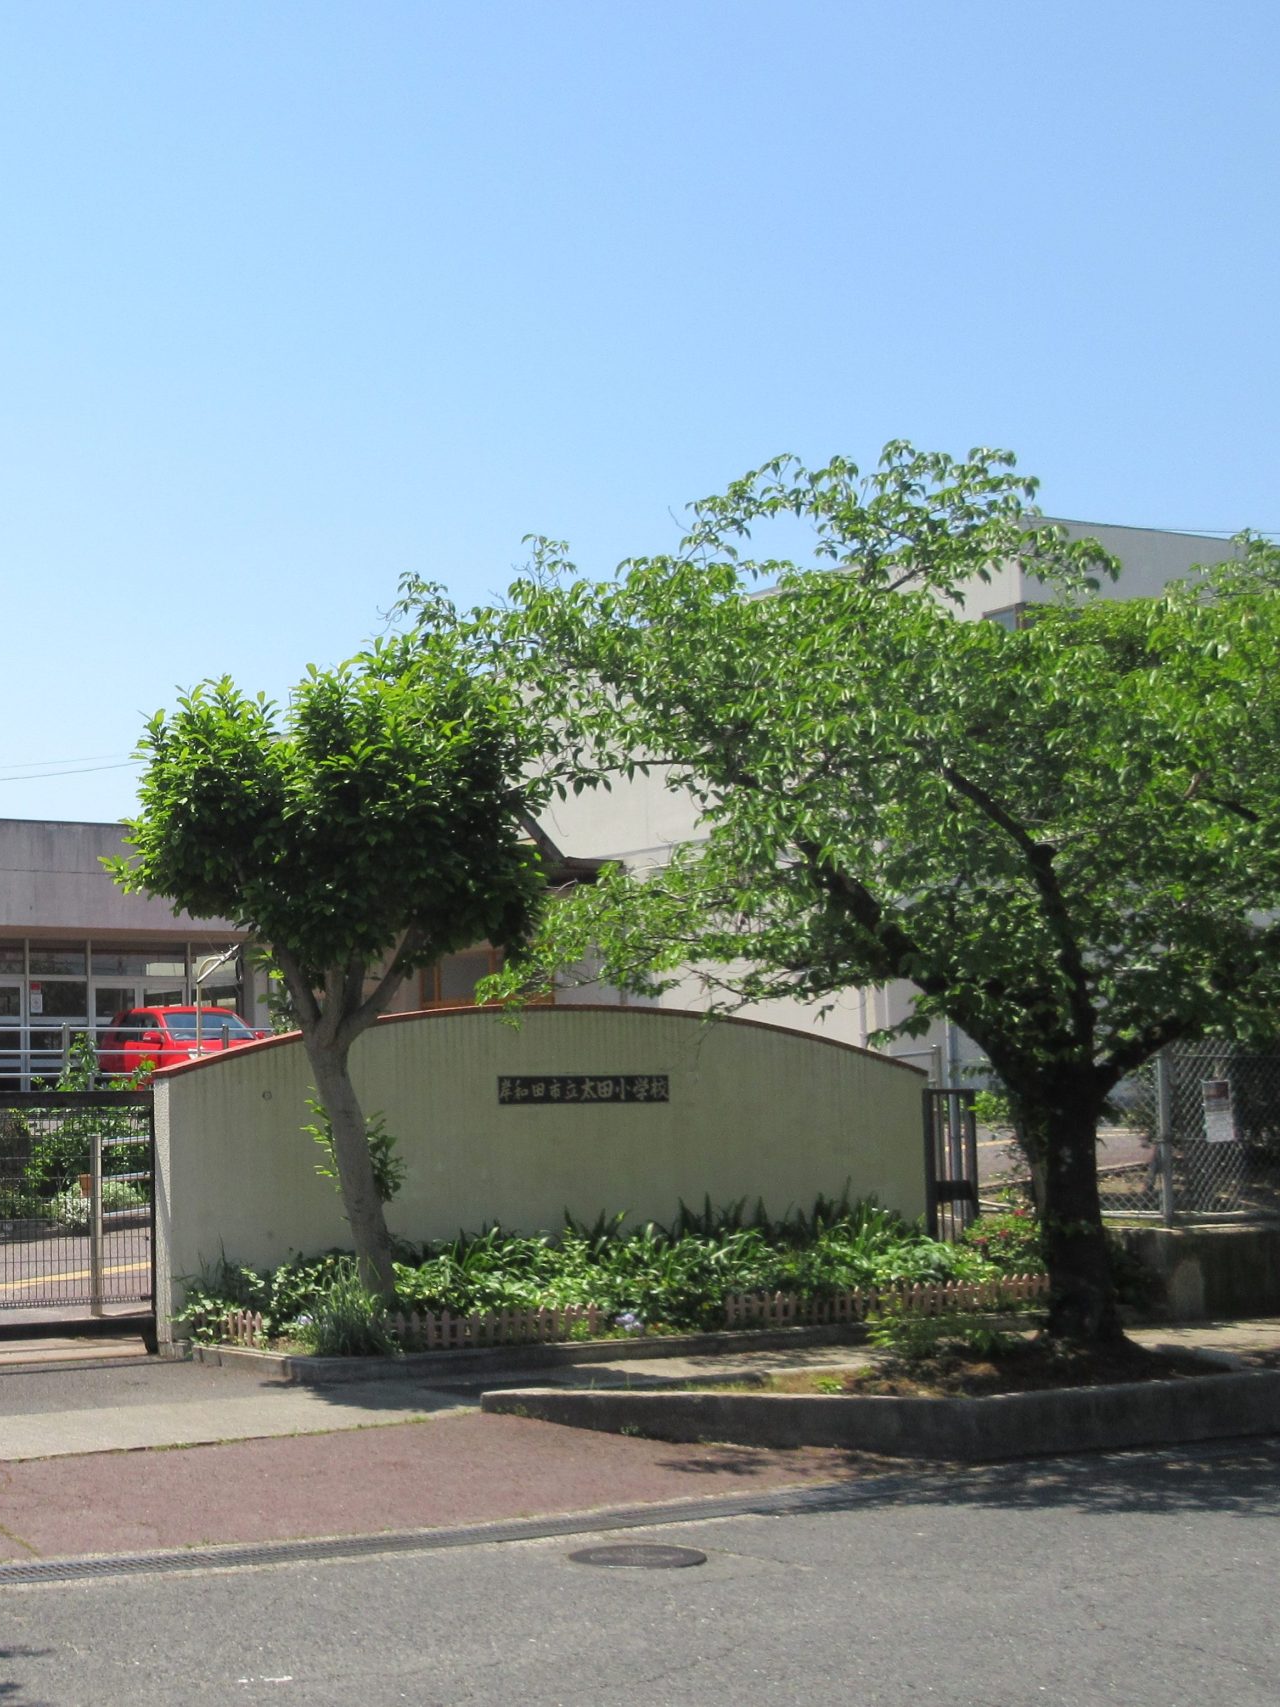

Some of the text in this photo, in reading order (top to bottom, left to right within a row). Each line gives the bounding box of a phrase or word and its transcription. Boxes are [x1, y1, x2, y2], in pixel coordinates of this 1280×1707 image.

[499, 1077, 669, 1101] 岸和田市立太田小学校
